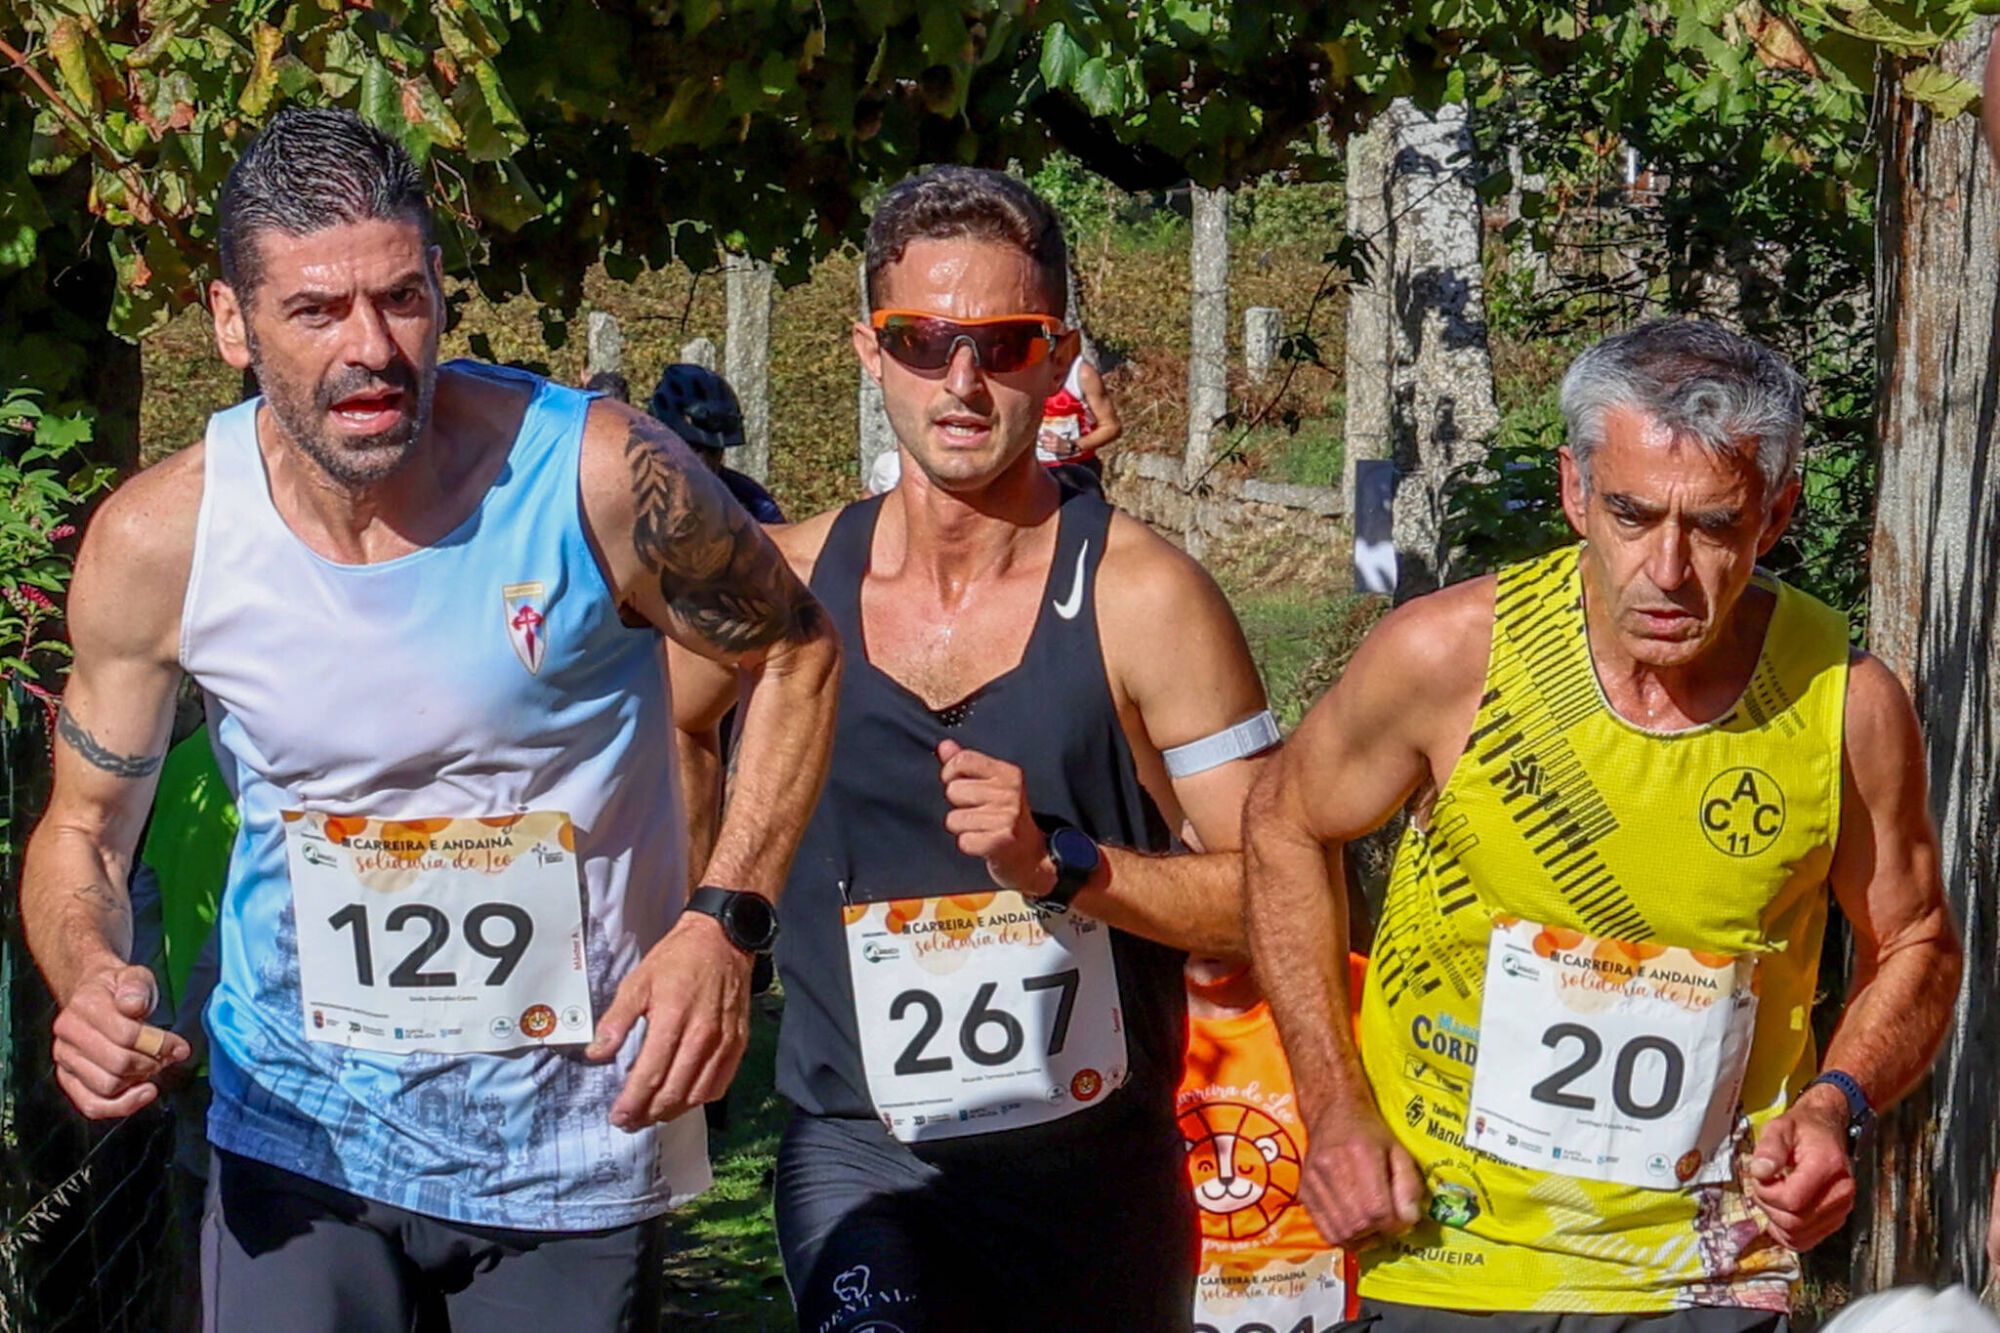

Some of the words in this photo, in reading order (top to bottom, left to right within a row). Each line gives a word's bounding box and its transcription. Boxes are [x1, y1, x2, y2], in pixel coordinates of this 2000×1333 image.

[353, 837, 426, 852] CARREIRA
[430, 838, 438, 851] E
[443, 836, 514, 852] ANDAINA
[1726, 831, 1751, 855] 11
[356, 849, 447, 873] solidaria
[452, 850, 478, 870] de
[485, 849, 515, 875] Leo
[912, 919, 975, 935] CARREIRA
[978, 918, 985, 928] E
[989, 910, 1053, 927] ANDAINA
[327, 902, 534, 987] 129
[915, 928, 994, 956] solidaria
[998, 925, 1022, 944] de
[1562, 954, 1634, 977] CARREIRA
[1637, 965, 1646, 979] E
[1649, 967, 1719, 990] ANDAINA
[1560, 968, 1649, 1000] solidaria
[1653, 981, 1682, 1002] de
[1683, 985, 1714, 1011] Leo
[889, 968, 1080, 1076] 267
[1411, 1013, 1478, 1067] CORD
[1530, 1021, 1685, 1121] 20
[1200, 1275, 1249, 1286] CARREIRA
[1262, 1271, 1307, 1283] ANDAINA
